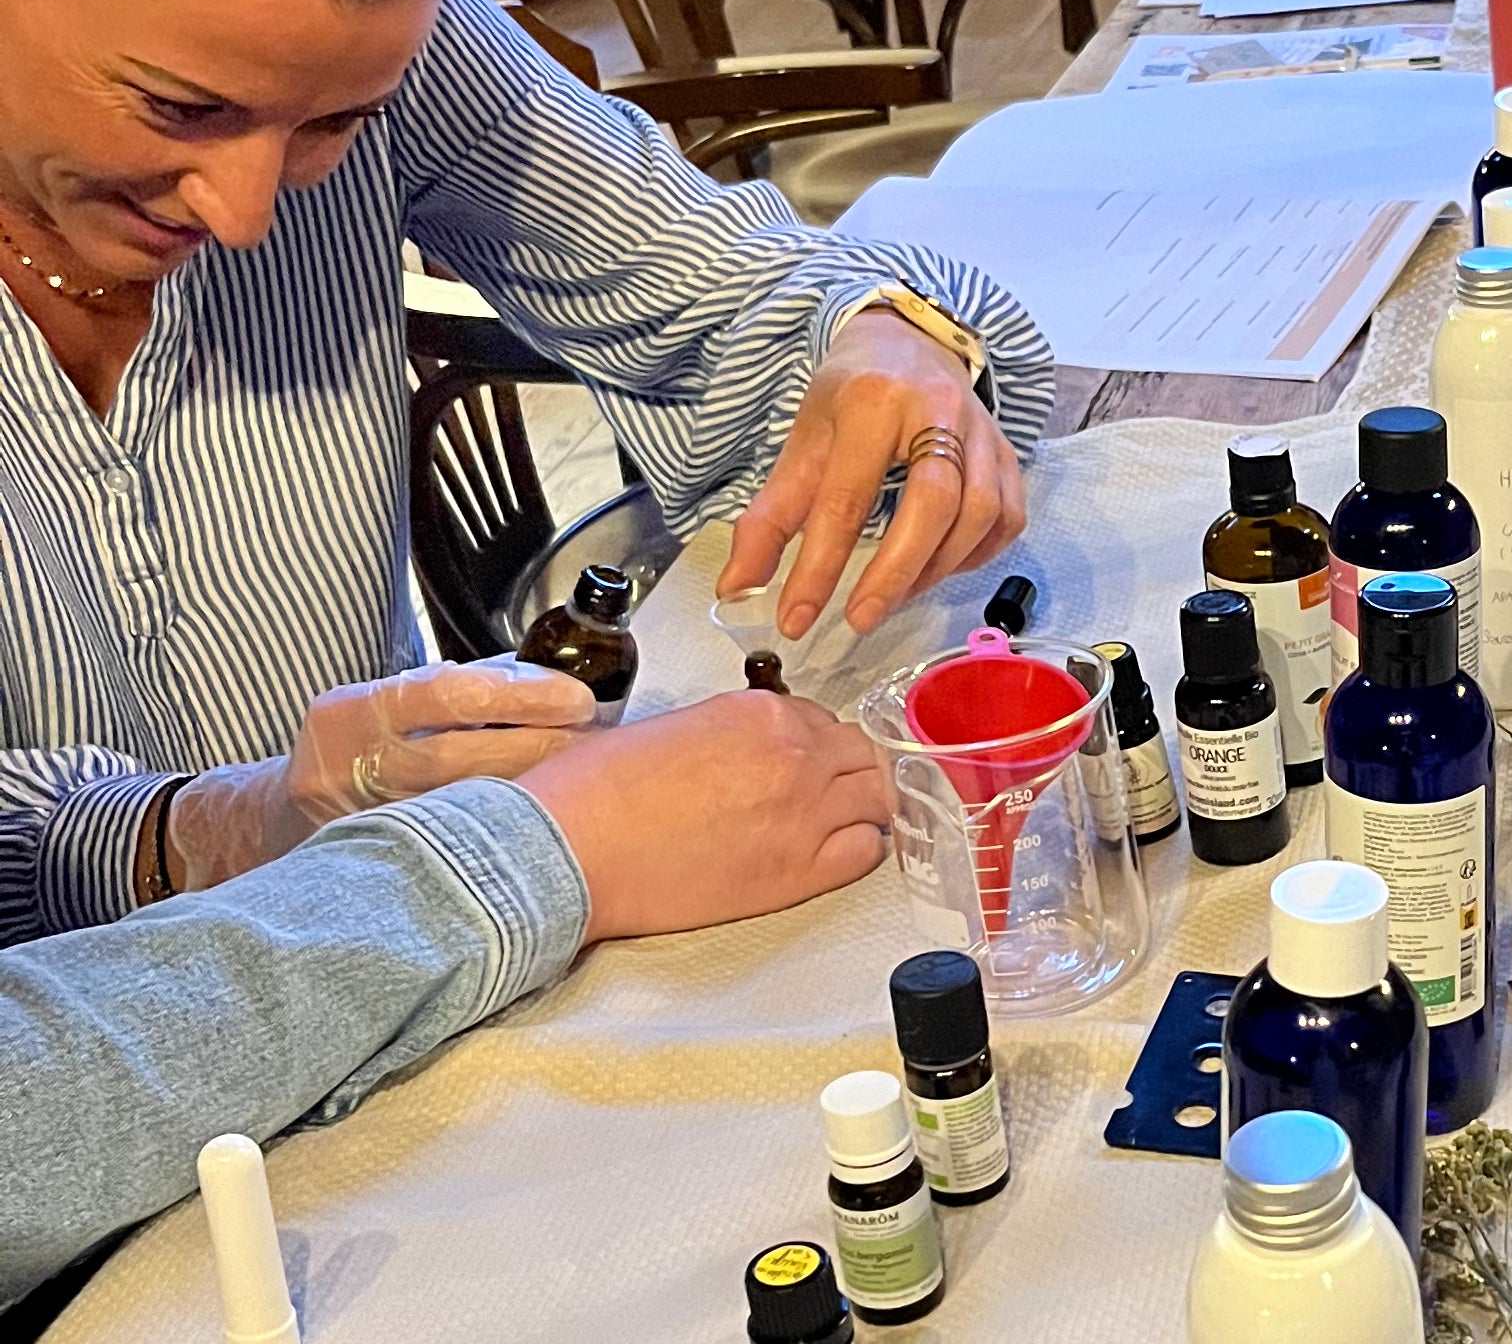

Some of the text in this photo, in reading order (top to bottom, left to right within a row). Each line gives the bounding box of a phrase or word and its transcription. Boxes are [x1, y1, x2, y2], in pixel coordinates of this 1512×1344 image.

[1189, 745, 1247, 764] ORANGE
[1204, 765, 1229, 773] DOUCE
[1005, 789, 1033, 806] 250
[1013, 835, 1041, 851] 200
[1022, 874, 1049, 892] 150
[1029, 917, 1057, 934] 100
